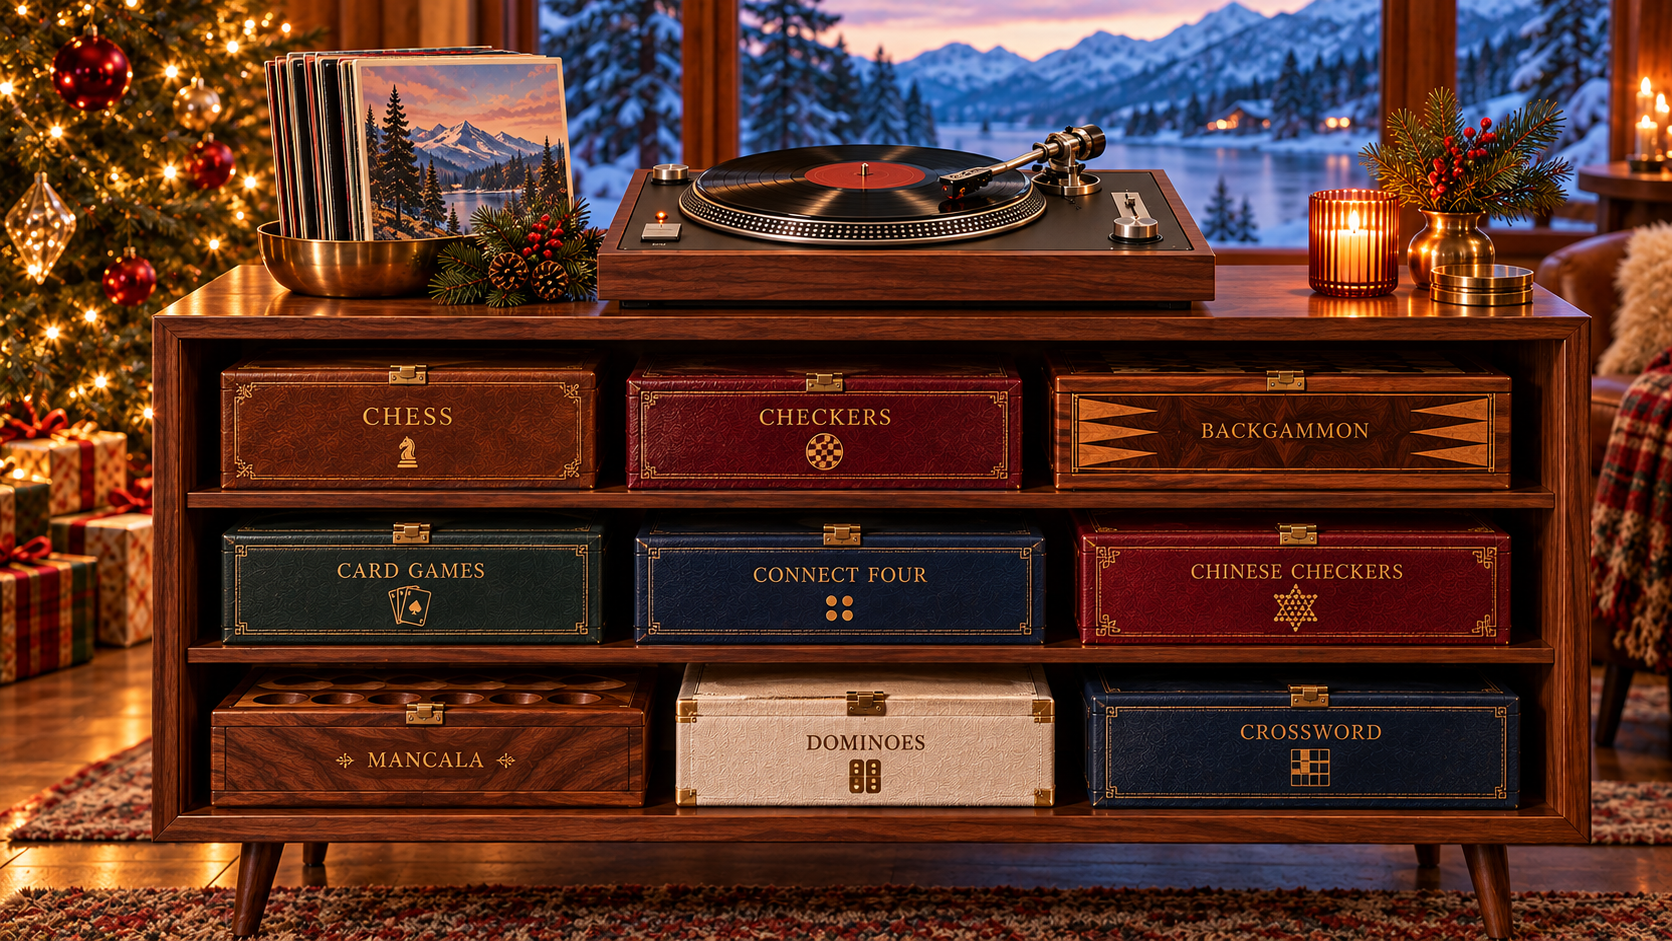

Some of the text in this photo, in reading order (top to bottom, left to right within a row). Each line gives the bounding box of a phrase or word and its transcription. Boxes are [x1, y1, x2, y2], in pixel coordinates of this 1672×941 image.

[362, 406, 453, 427] CHESS
[759, 407, 891, 427] CHECKERS
[1201, 422, 1369, 439] BACKGAMMON
[337, 562, 485, 579] CARD GAMES
[753, 566, 927, 583] CONNECT FOUR
[1191, 562, 1403, 580] CHINESE CHECKERS
[1240, 723, 1382, 741] CROSSWORD
[806, 733, 926, 751] DOMINOES
[367, 751, 484, 769] MANCALA
